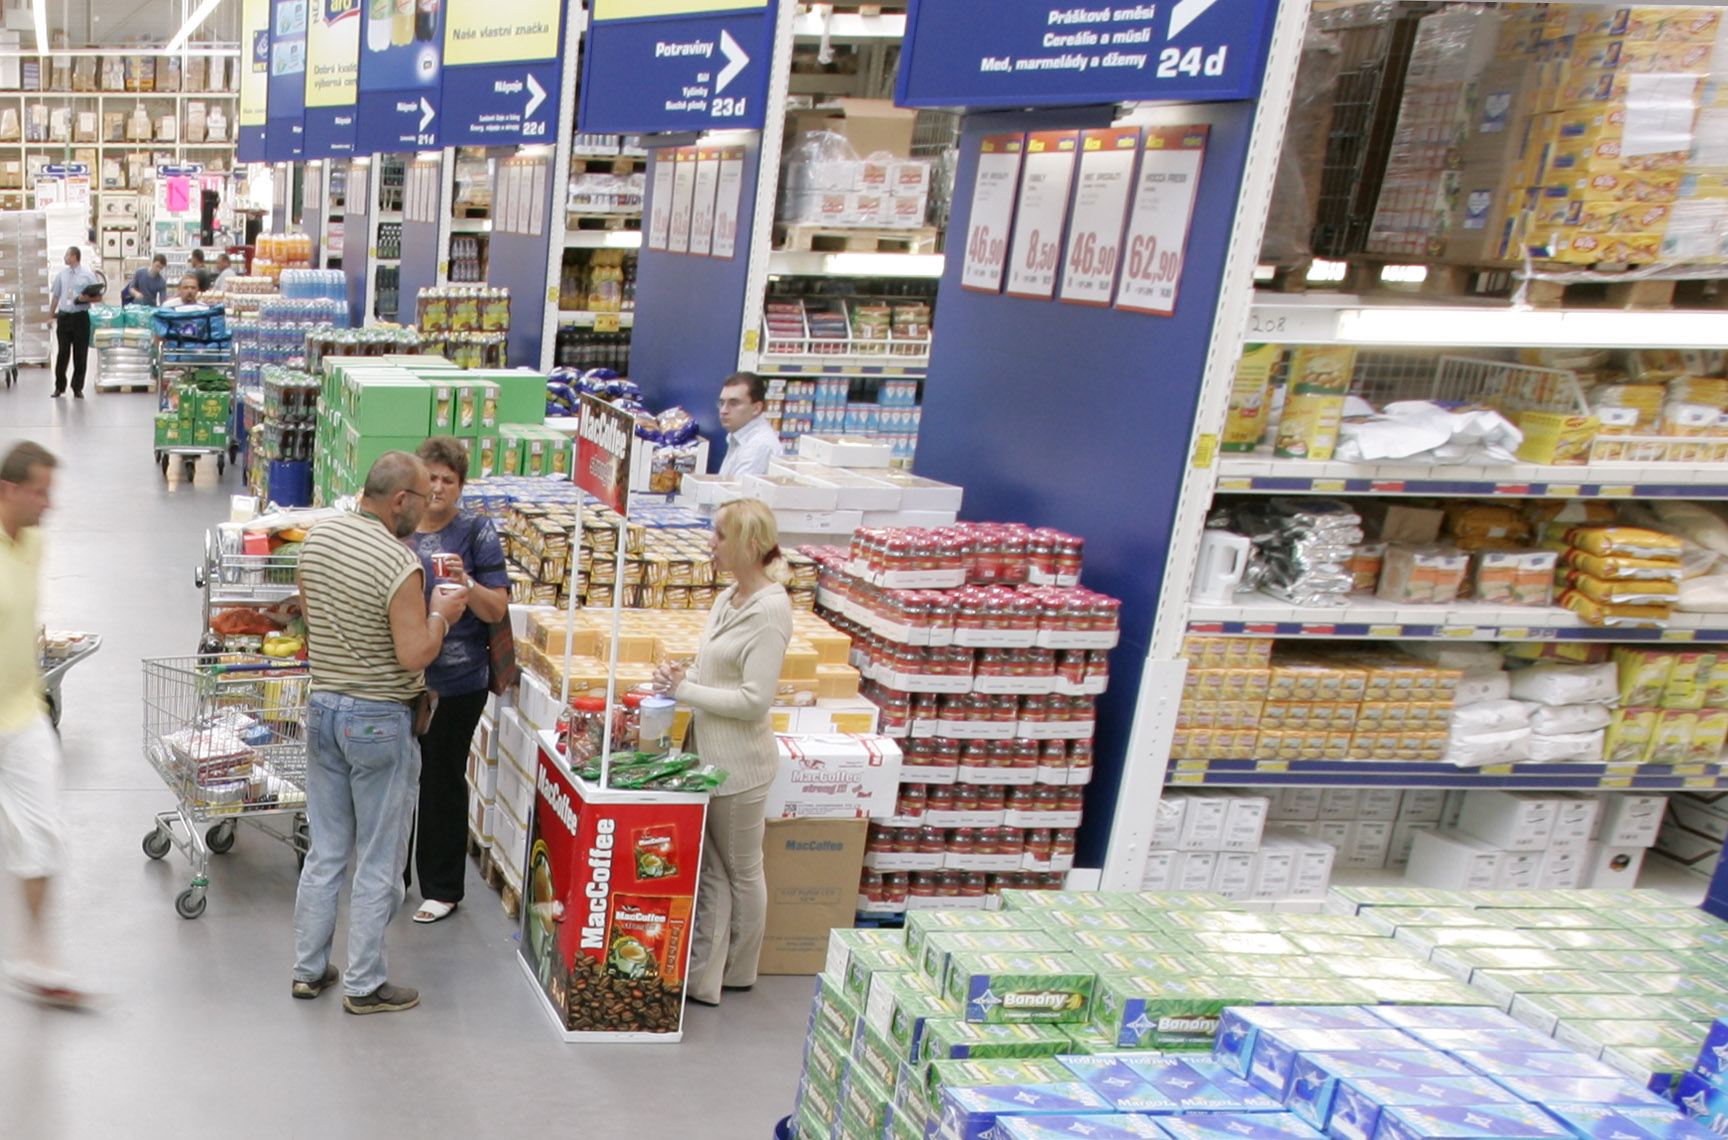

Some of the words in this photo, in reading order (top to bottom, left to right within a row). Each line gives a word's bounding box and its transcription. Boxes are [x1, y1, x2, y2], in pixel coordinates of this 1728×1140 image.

[1048, 8, 1110, 25] Práškové
[1113, 4, 1155, 21] směsi
[453, 28, 478, 40] Naše
[1043, 32, 1097, 47] Cereálie
[1100, 35, 1109, 44] a
[1113, 27, 1151, 43] müsli
[655, 39, 714, 58] Potraviny
[980, 57, 1013, 72] Med,
[1015, 54, 1087, 71] marmelády
[1090, 57, 1100, 68] a
[1102, 51, 1147, 69] džemy
[969, 225, 1004, 267] 46,90
[1026, 229, 1056, 273] 8,50
[1070, 232, 1116, 278] 46,90
[1128, 235, 1178, 284] 62,90
[579, 402, 627, 460] MacCoffee
[791, 769, 863, 783] MacCoffee
[536, 763, 578, 837] MacCoffee
[785, 839, 844, 851] MacCoffee
[581, 818, 616, 949] MacCoffee
[615, 909, 667, 924] MacCoffee
[1003, 990, 1069, 1010] Banány
